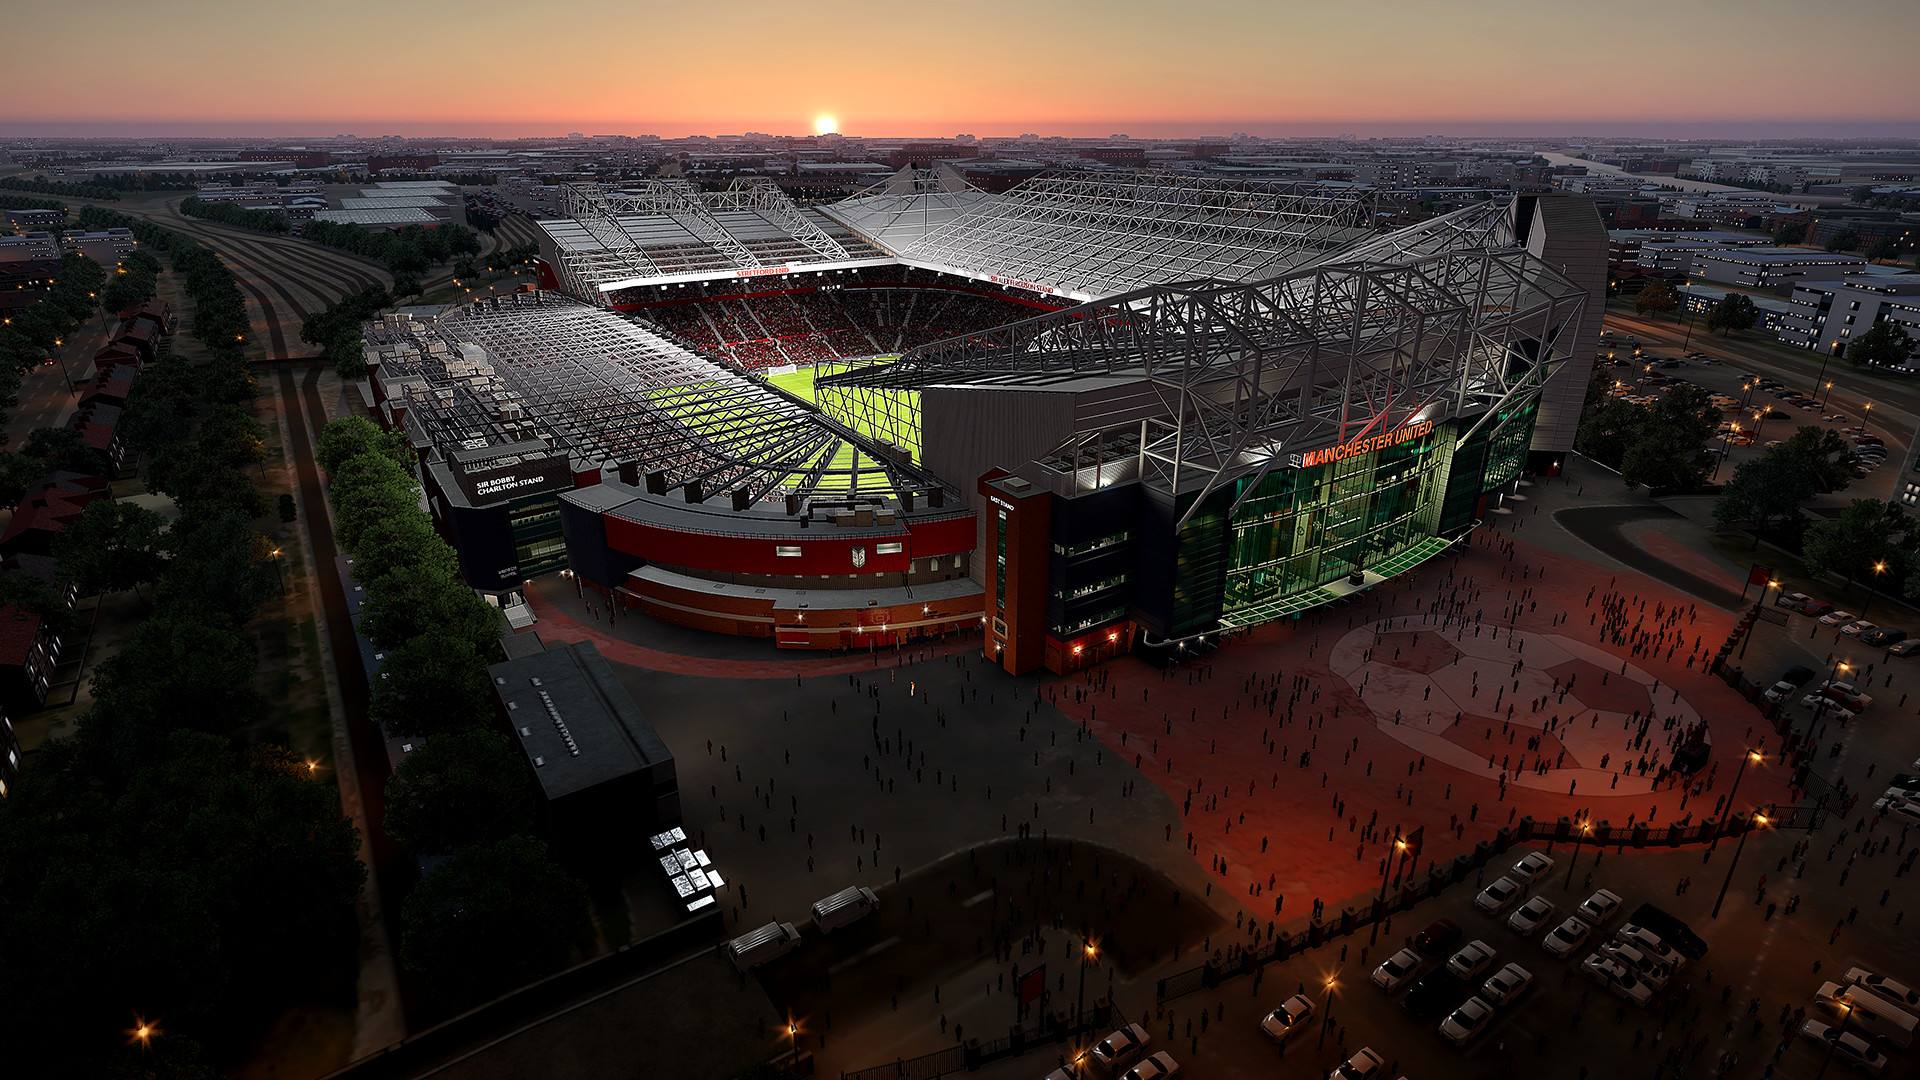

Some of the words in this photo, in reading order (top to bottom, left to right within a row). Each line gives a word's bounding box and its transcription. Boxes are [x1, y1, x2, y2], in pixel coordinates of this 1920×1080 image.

[1303, 432, 1393, 468] MANCHESTER
[1395, 420, 1433, 444] UNITED
[476, 480, 490, 490] SIR
[490, 475, 515, 486] BOBBY
[477, 481, 518, 496] CHARLTON
[519, 475, 544, 487] STAND
